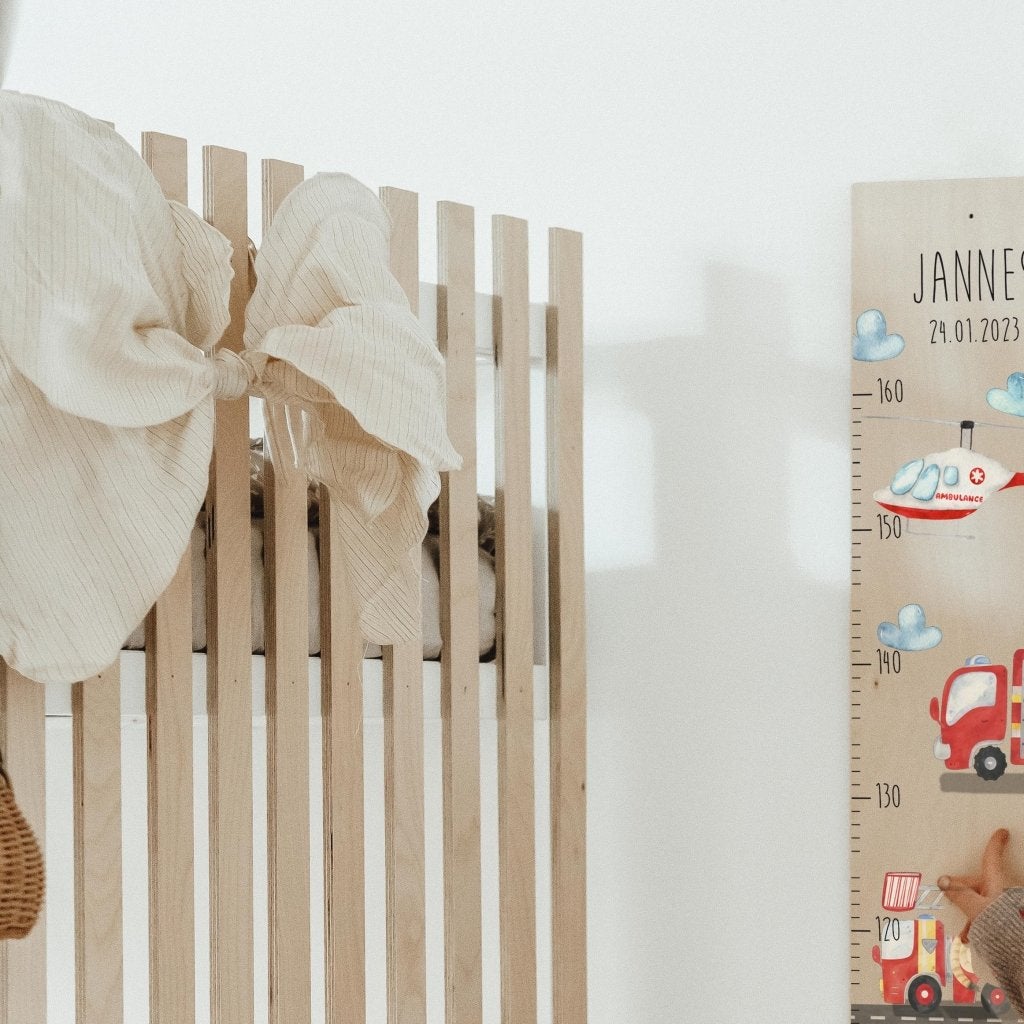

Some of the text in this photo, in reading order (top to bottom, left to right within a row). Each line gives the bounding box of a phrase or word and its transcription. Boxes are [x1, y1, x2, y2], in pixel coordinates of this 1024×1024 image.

[929, 316, 1021, 344] 24.01.2023
[877, 377, 904, 404] 160
[935, 492, 984, 503] AMBULANCE
[876, 513, 902, 540] 150
[876, 648, 901, 674] 140
[875, 782, 901, 808] 130
[875, 915, 901, 942] 120
